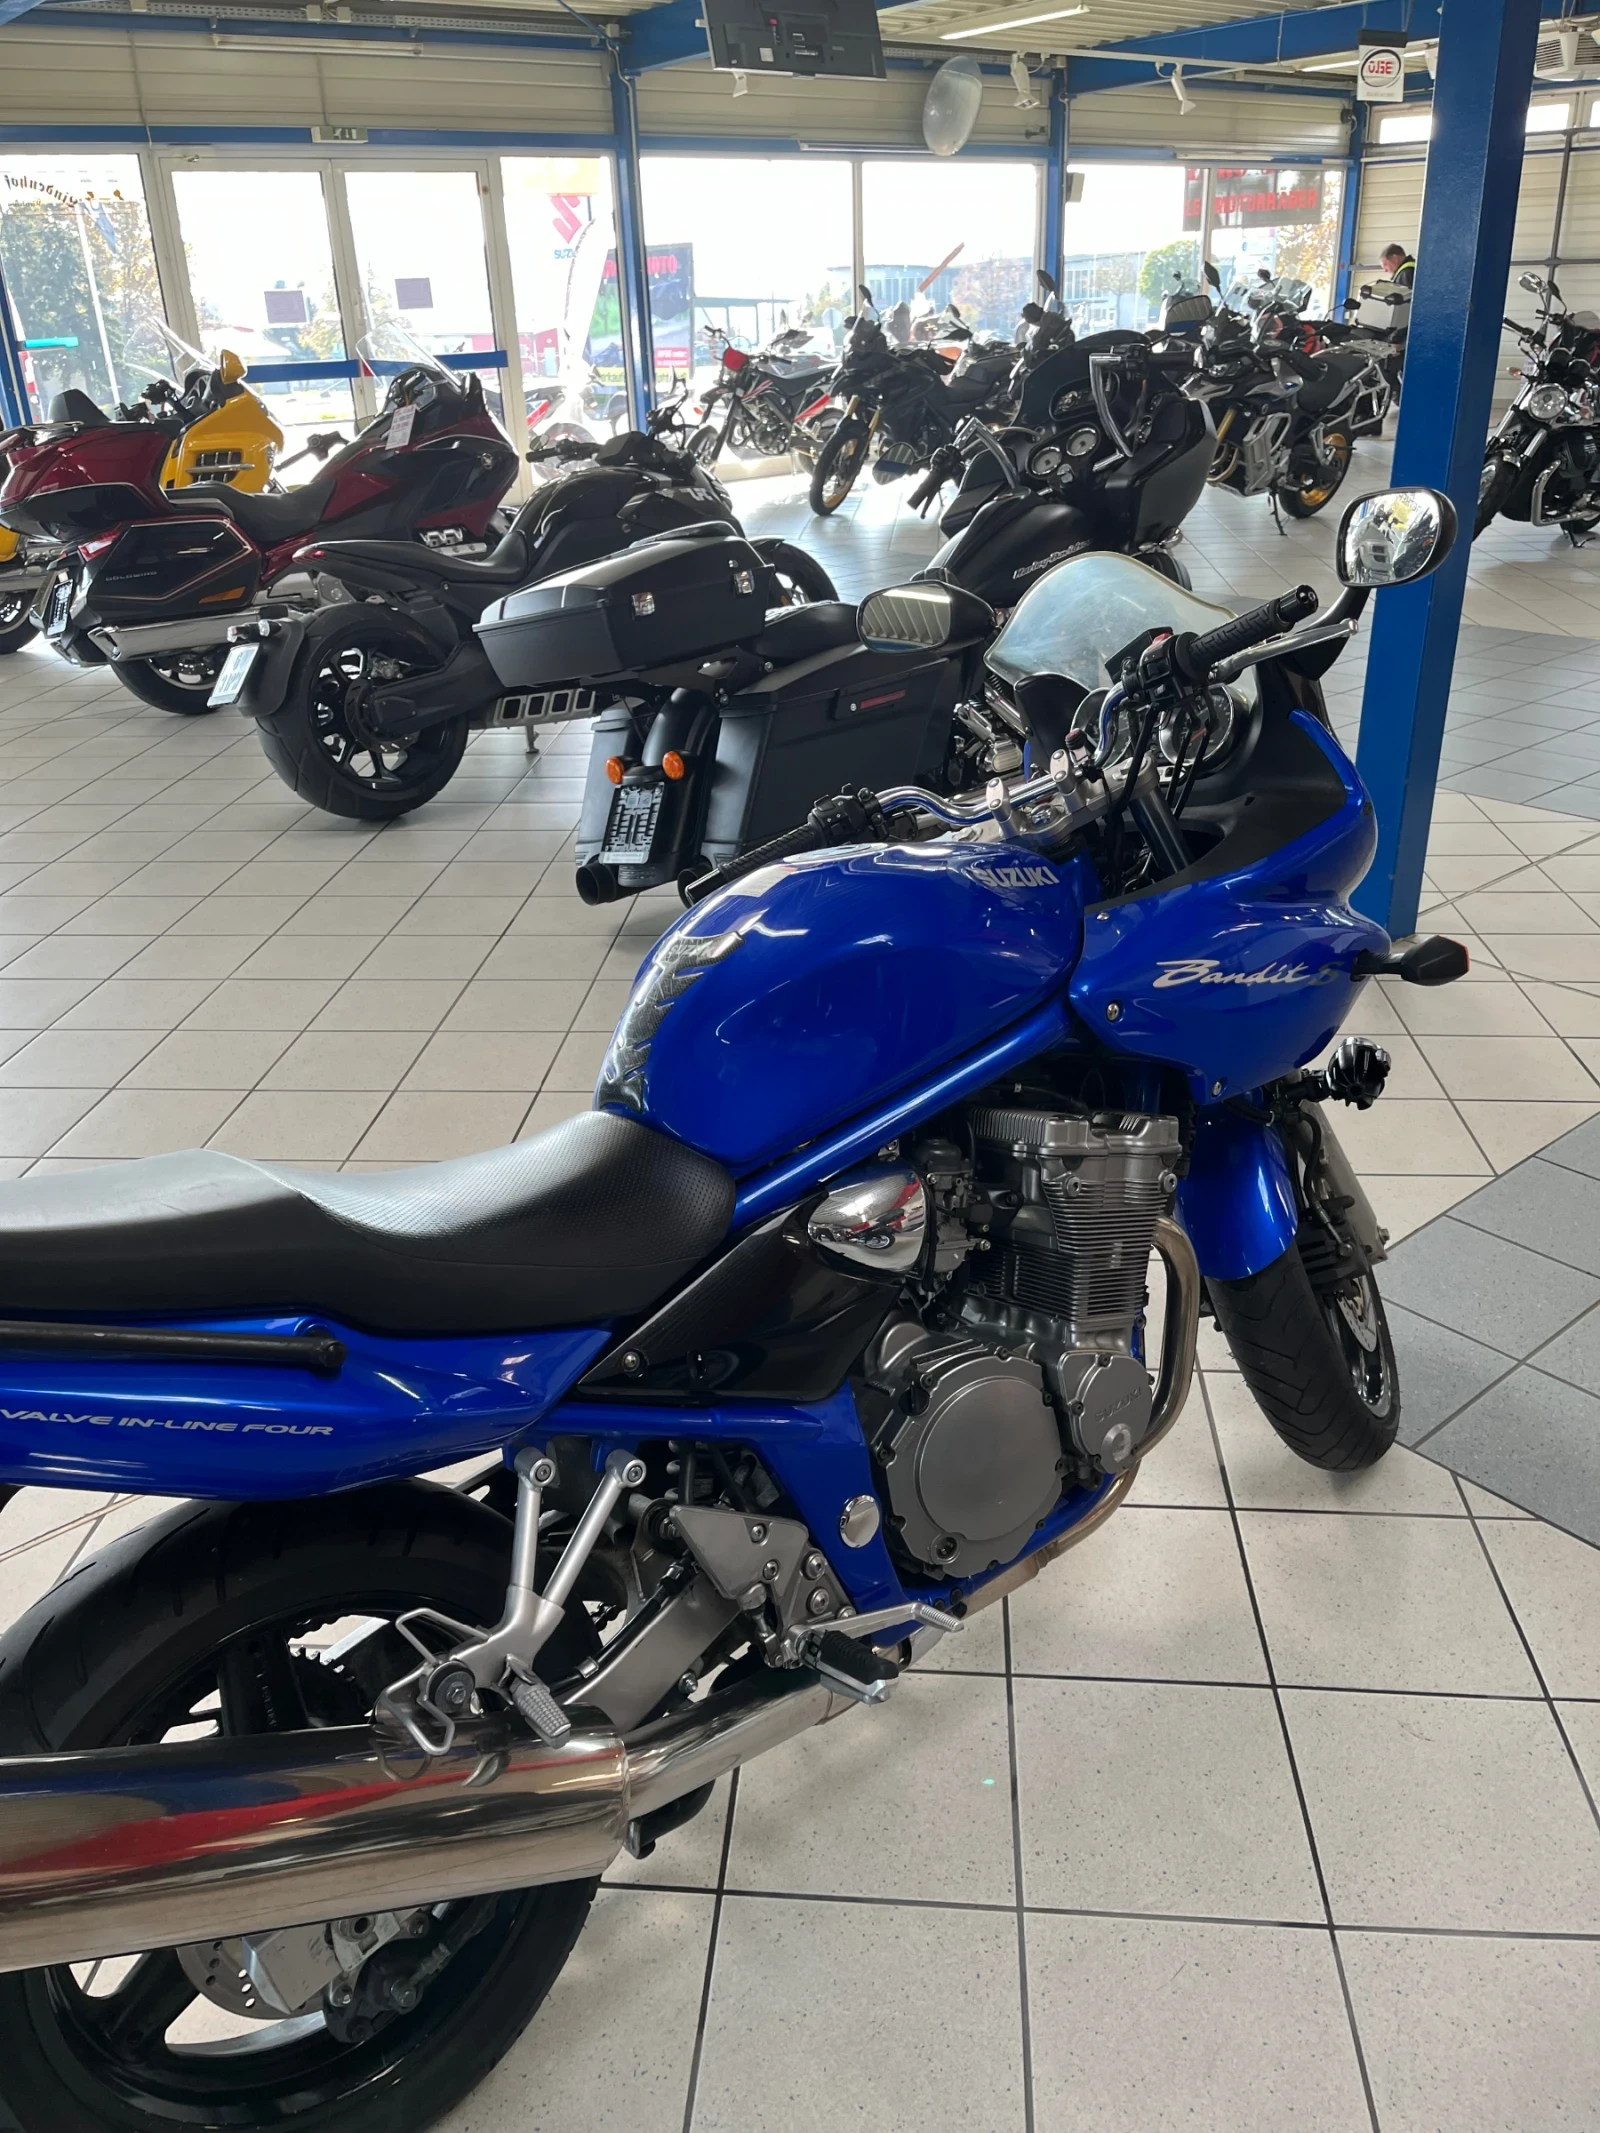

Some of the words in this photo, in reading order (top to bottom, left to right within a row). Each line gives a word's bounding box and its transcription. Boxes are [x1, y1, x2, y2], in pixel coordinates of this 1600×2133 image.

[974, 866, 1060, 888] SUZUKI
[1153, 959, 1311, 989] Bandit
[1095, 1387, 1142, 1423] SUZUKI
[0, 1409, 114, 1426] VALVE
[118, 1417, 238, 1432] IN-LINE
[242, 1423, 334, 1436] FOUR
